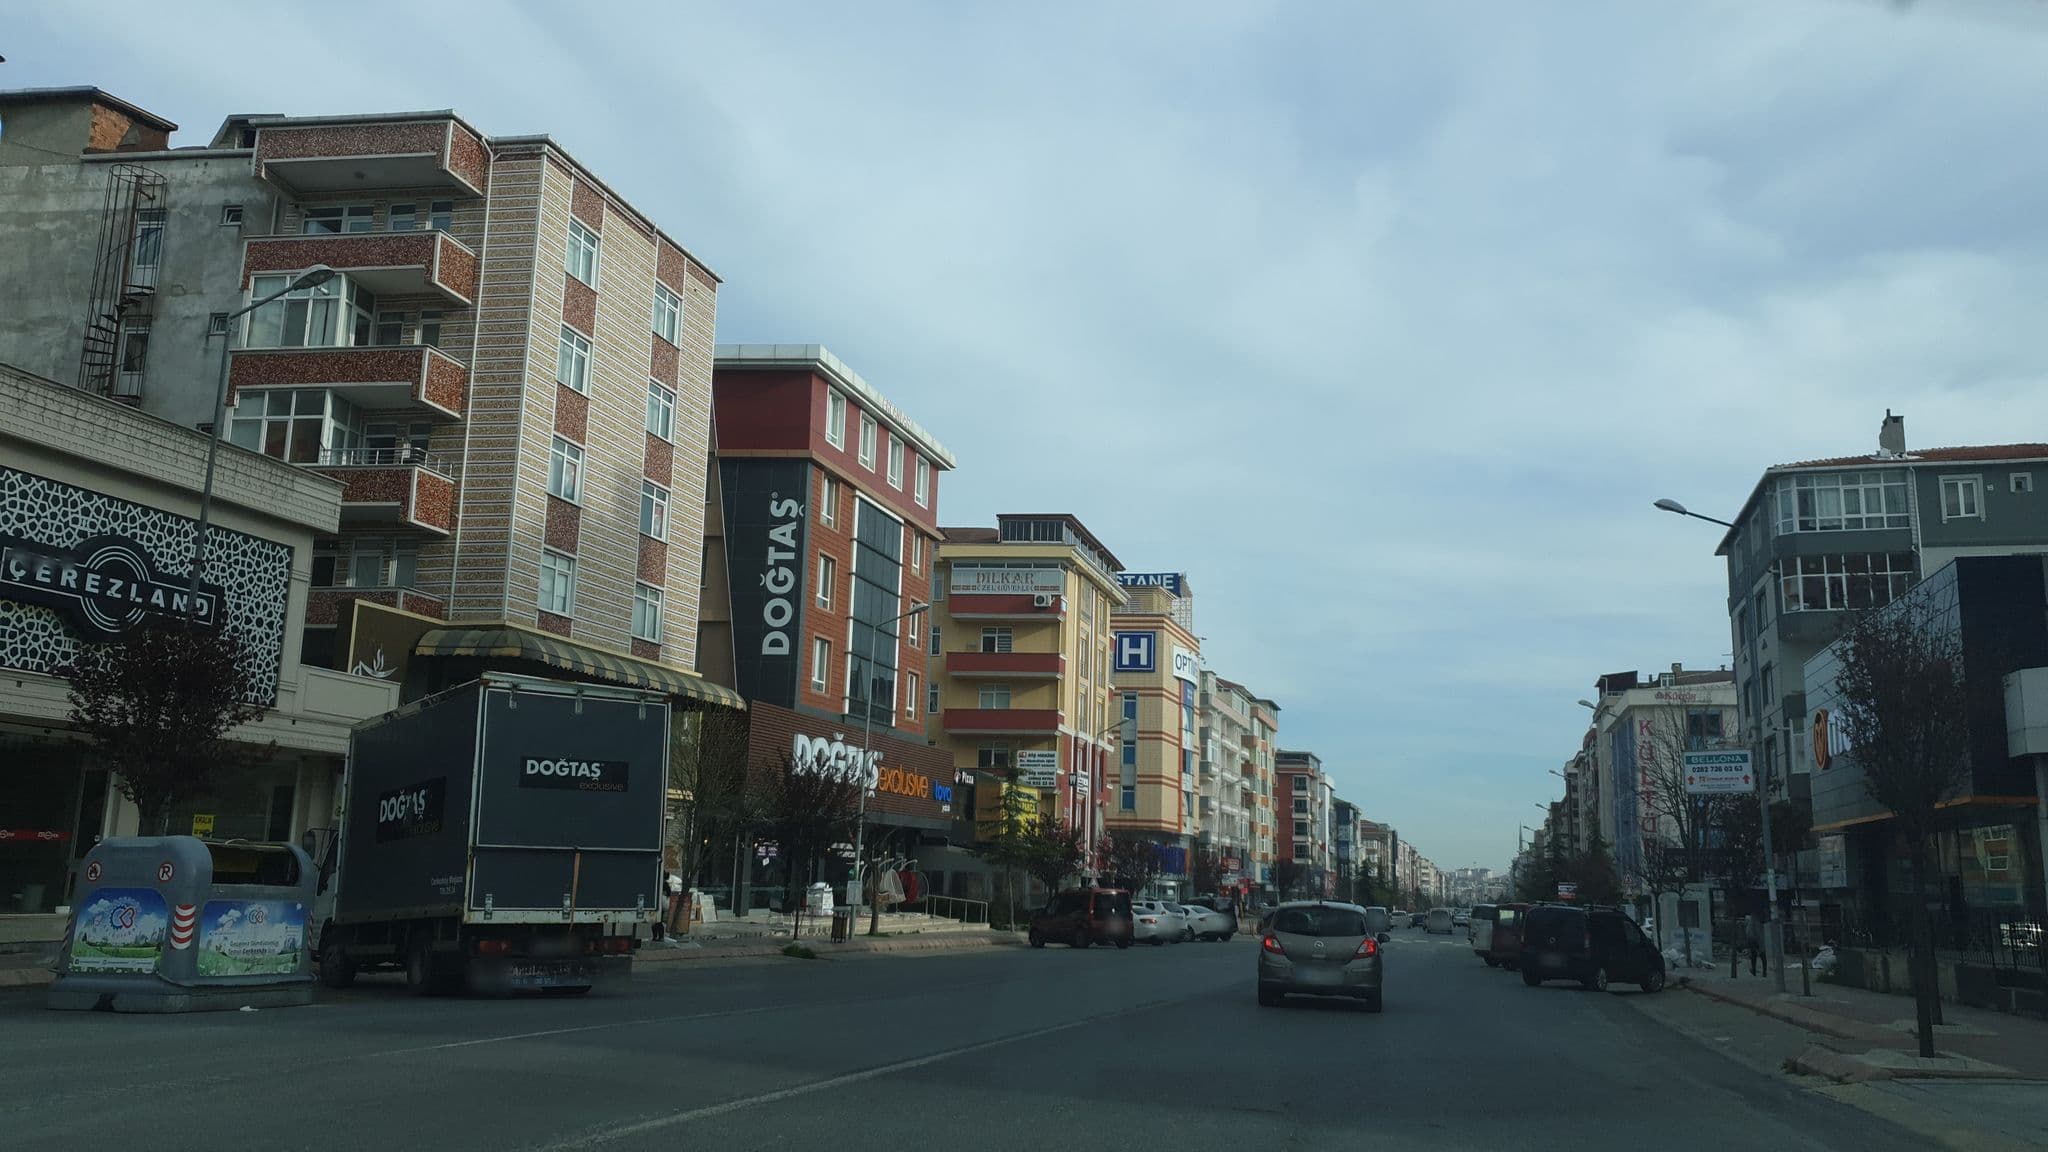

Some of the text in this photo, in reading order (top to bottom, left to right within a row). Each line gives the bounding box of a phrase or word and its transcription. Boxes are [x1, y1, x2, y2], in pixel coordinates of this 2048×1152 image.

[9, 558, 209, 617] ÇEREZLAND
[760, 498, 805, 656] DOĞTAŞ
[1121, 636, 1149, 666] H
[526, 758, 602, 782] DOĞTAŞ
[1691, 754, 1743, 764] BELLONA
[878, 764, 929, 799] exclusive
